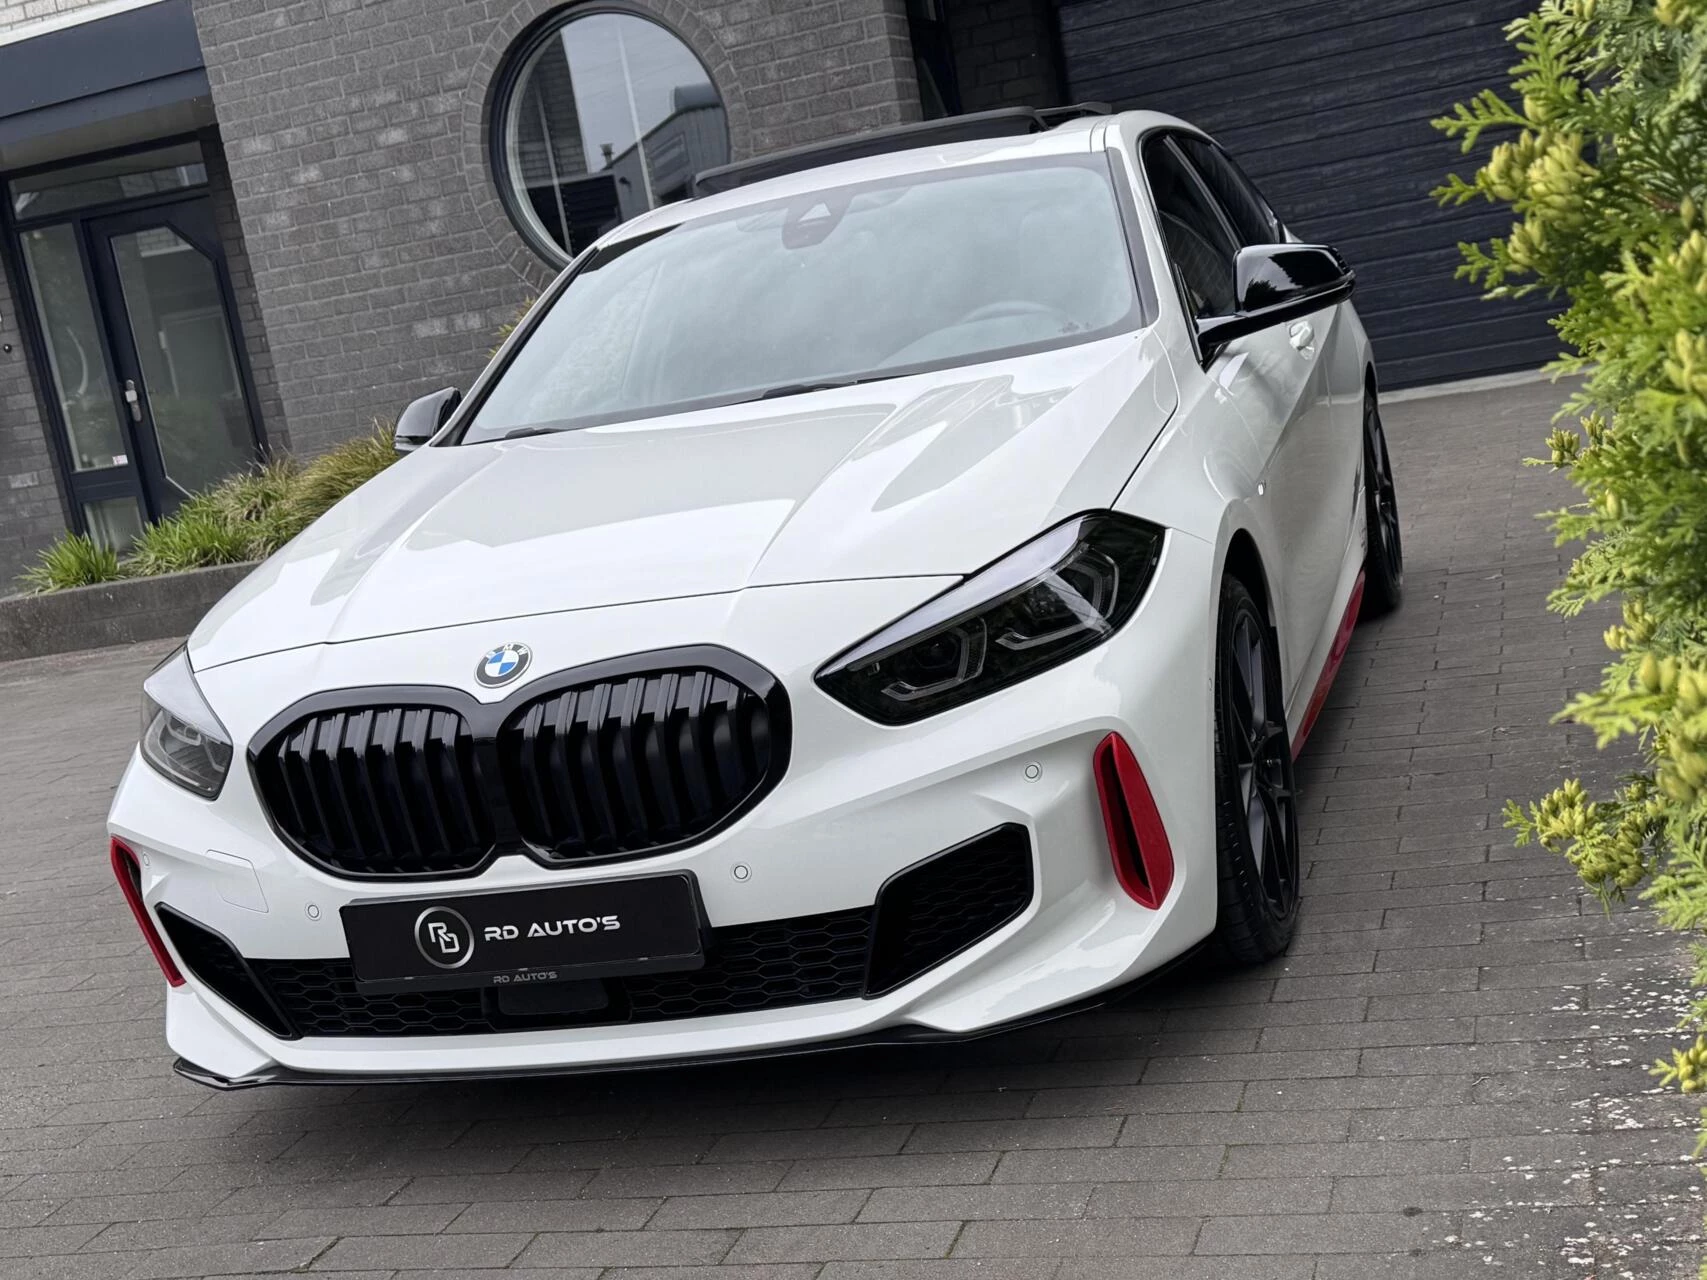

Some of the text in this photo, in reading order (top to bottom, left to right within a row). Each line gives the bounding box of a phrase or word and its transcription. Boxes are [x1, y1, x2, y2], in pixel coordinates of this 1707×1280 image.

[484, 915, 621, 941] RD AUTO'S
[493, 971, 558, 983] RD AUTO'S
